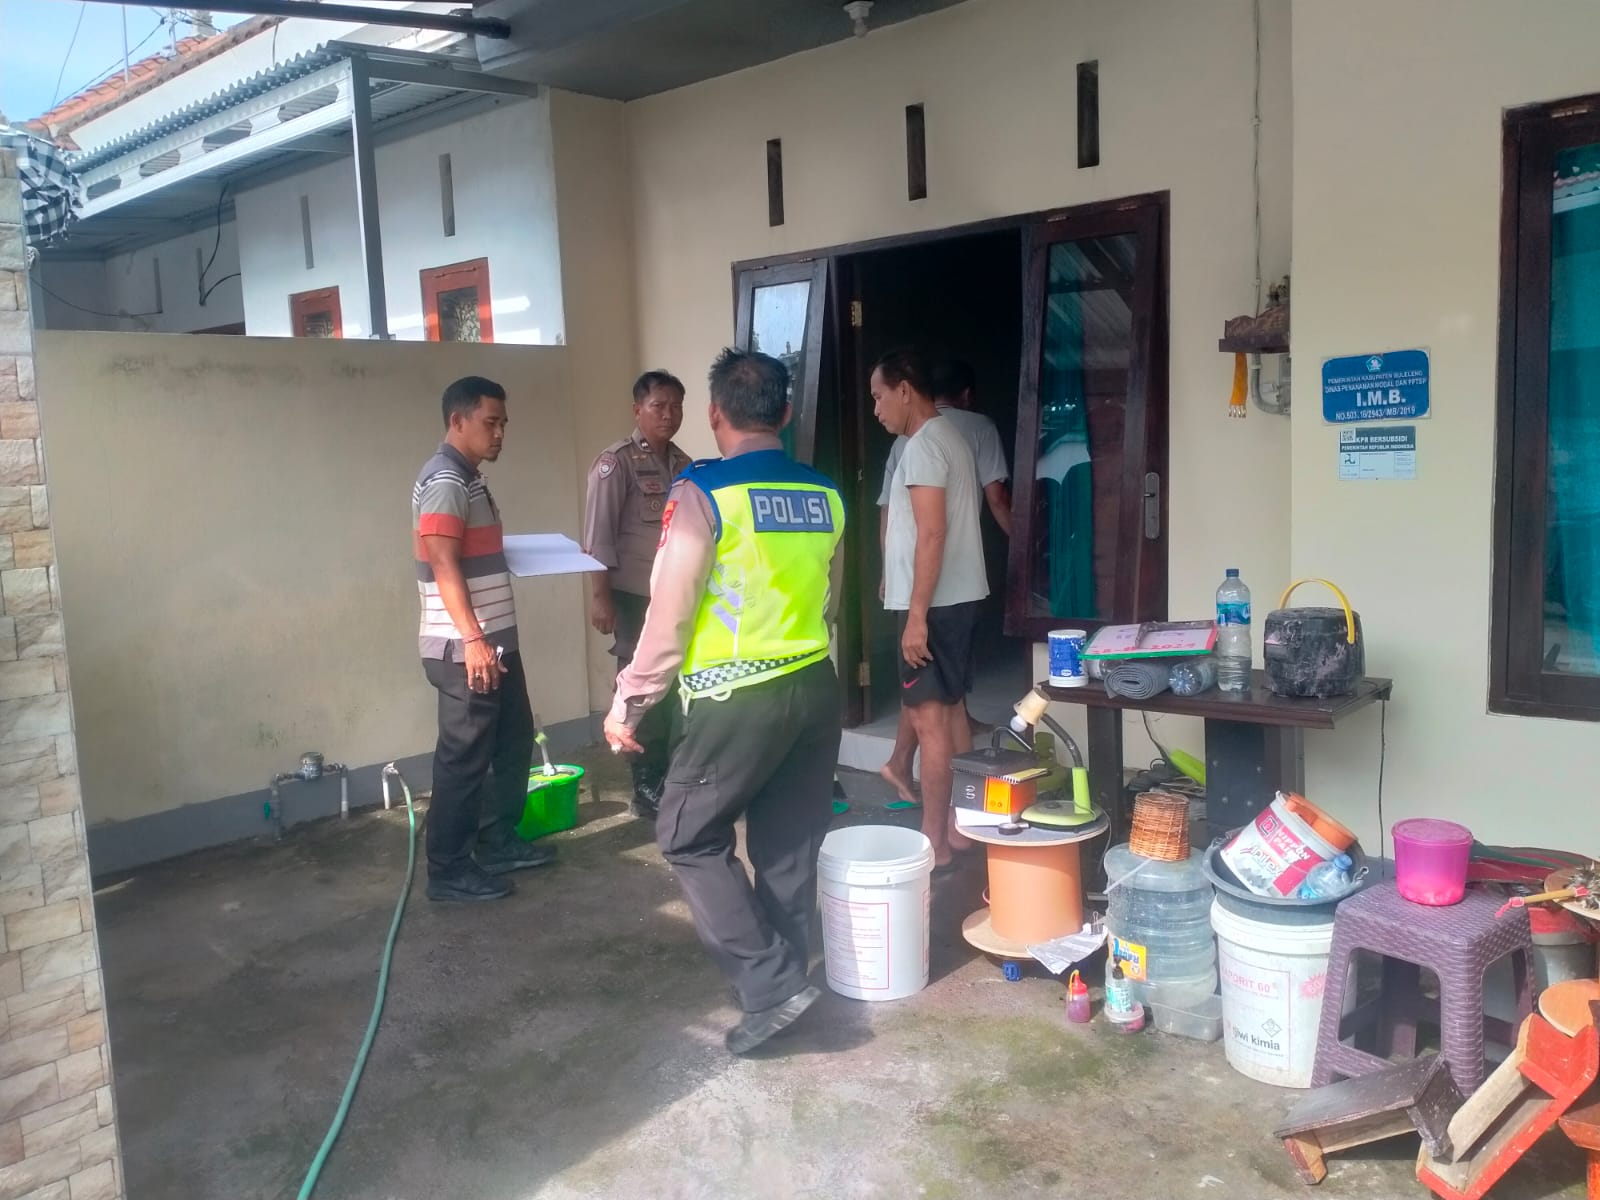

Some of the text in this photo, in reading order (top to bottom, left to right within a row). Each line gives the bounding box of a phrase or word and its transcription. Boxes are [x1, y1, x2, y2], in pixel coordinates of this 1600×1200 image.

[1356, 389, 1406, 407] I.M.B.
[1370, 435, 1408, 443] BERSUBSIDI
[754, 496, 830, 525] POLISI
[1276, 831, 1311, 859] NIPPON
[1251, 1034, 1281, 1051] kimia
